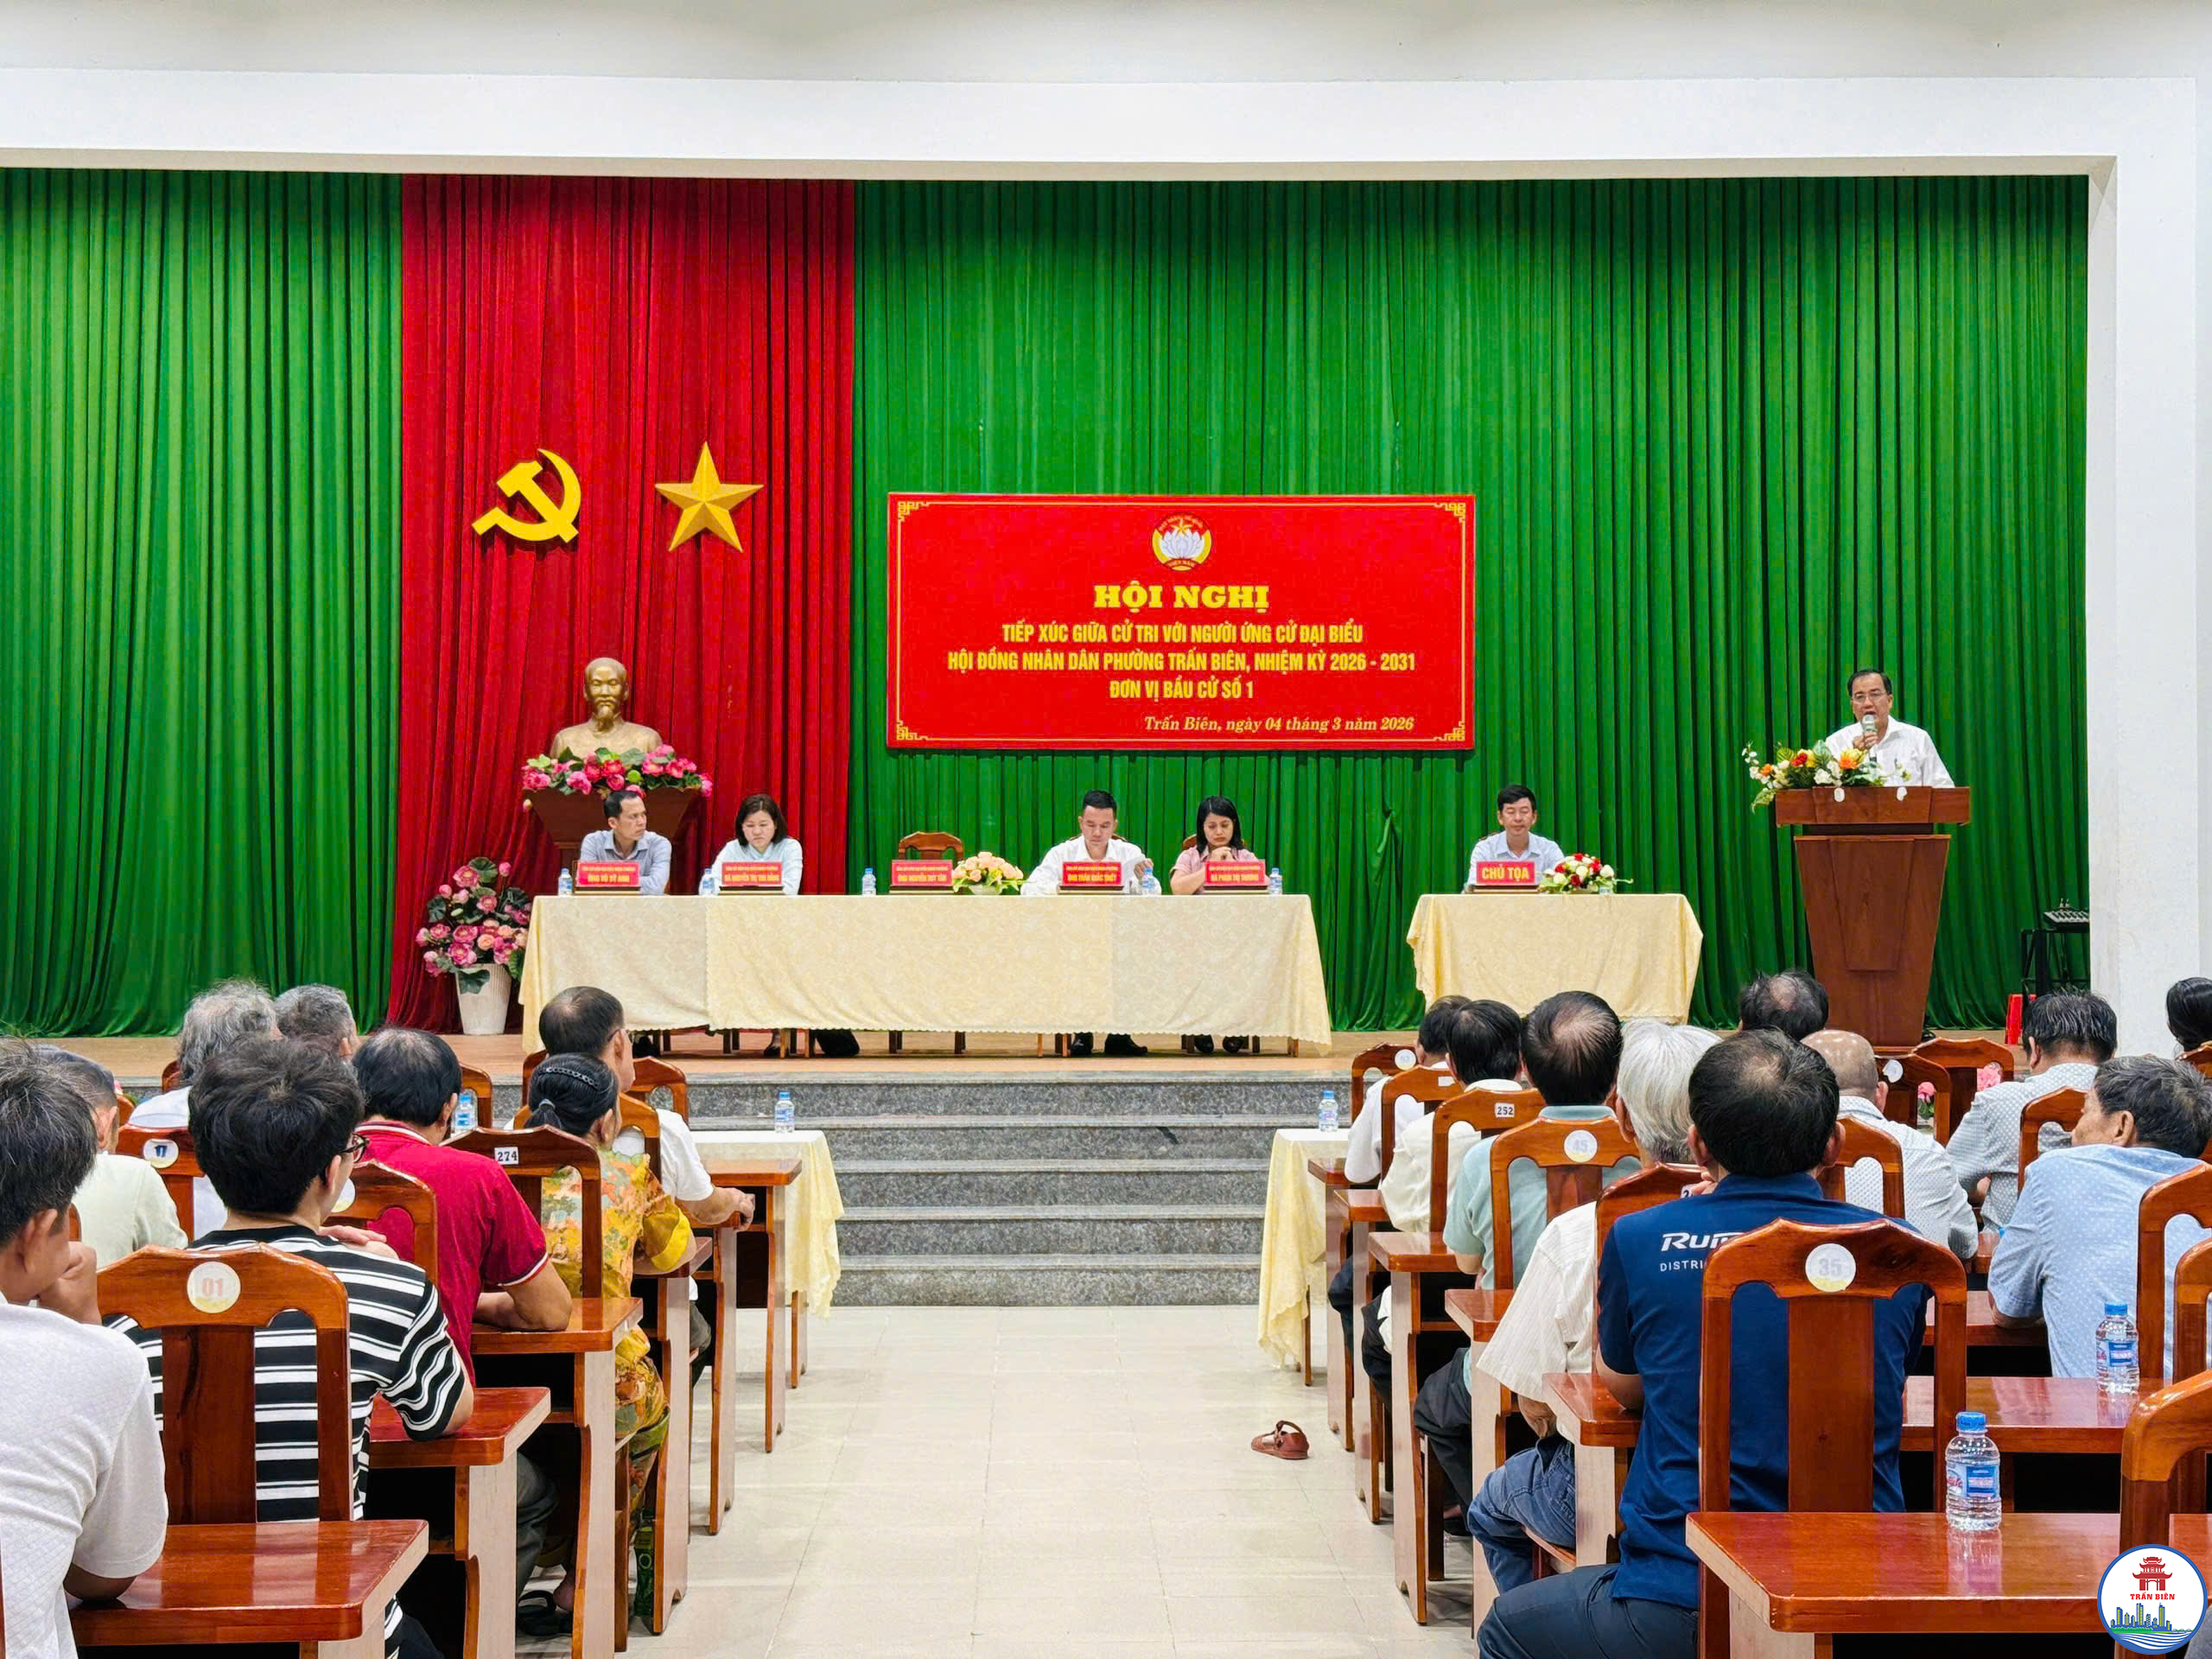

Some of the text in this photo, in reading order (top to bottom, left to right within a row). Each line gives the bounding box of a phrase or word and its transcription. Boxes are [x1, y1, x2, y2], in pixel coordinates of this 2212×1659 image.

[1094, 580, 1269, 613] HỘI NGHỊ
[1002, 617, 1363, 647] TIẾP XÚC GIỮA CỬ TRI VỚI NGƯỜI ỨNG CỬ ĐẠI BIỂU
[948, 648, 974, 674] HỘI
[977, 645, 1019, 671] ĐỒNG
[1022, 649, 1065, 671] NHÂN
[1068, 648, 1100, 671] DÂN
[1103, 648, 1164, 671] PHƯỜNG
[1167, 646, 1207, 671] TRẤN
[1211, 649, 1250, 673] BIÊN,
[1254, 649, 1304, 675] NHIỆM
[1306, 649, 1327, 671] KỲ
[1329, 652, 1367, 671] 2026
[1380, 652, 1415, 671] 2031
[1109, 675, 1254, 702] ĐƠN VỊ BẦU CỬ SỐ 1
[1144, 715, 1414, 734] Trấn Biên, ngày 04 tháng 3 năm 2026
[1482, 864, 1529, 881] CHỦ TỌA
[1497, 1106, 1514, 1116] 252
[498, 1151, 518, 1161] 274
[1819, 1257, 1842, 1277] 35
[201, 1278, 222, 1298] 01
